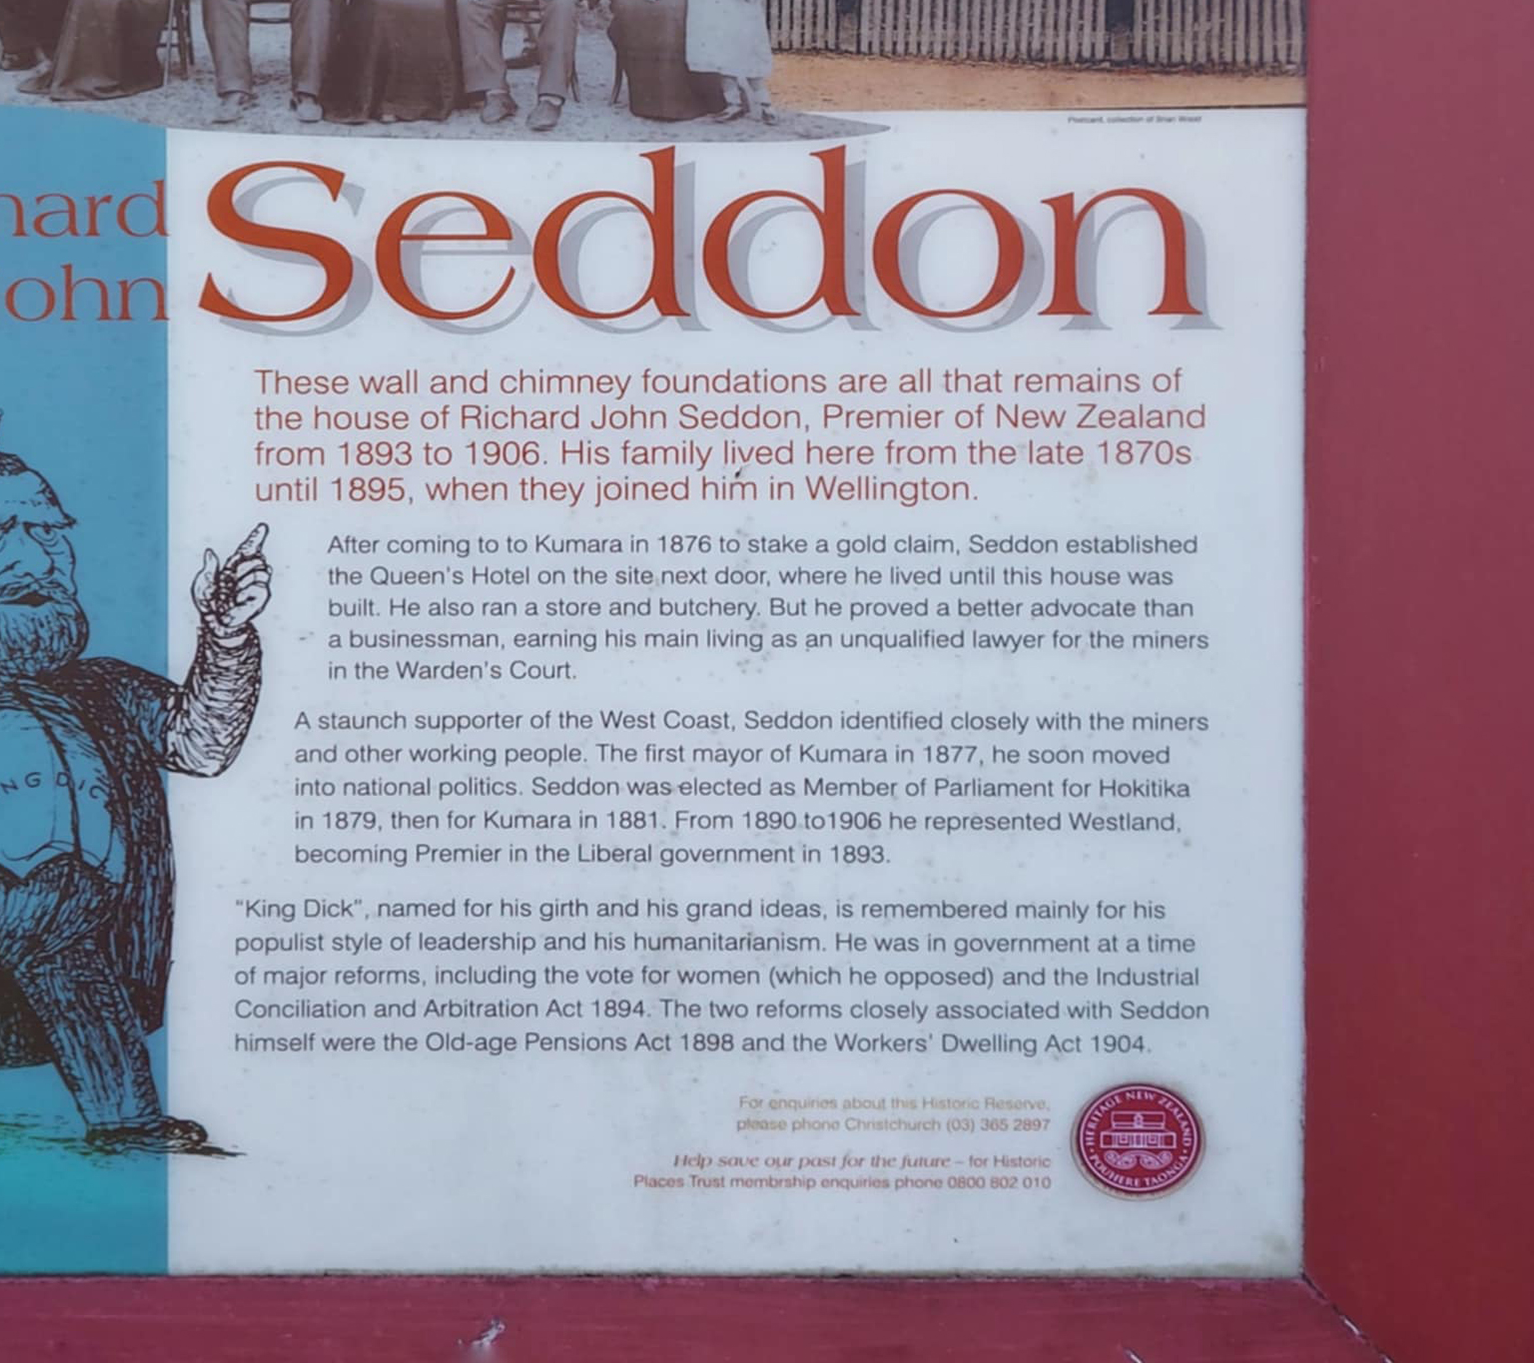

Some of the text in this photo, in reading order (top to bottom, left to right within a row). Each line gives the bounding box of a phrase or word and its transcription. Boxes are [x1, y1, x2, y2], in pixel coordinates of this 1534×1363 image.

[197, 145, 1204, 323] Seddon
[253, 366, 1183, 401] These wall and chimney foundations are all that remains of
[254, 399, 1206, 433] the house of Richard John Seddon, Premier of New Zealand
[254, 439, 1192, 475] from 1893 to 1906. His family lived here from the late 1870s
[255, 475, 978, 508] until 1895, when they joined him in Wellington.
[326, 533, 1198, 559] After coming to to Kumara in 1876 to stake a gold claim, Seddon established
[738, 1094, 1051, 1112] For enquiries about this Historic Reserve,
[1085, 1089, 1193, 1146] HERITAGE NEW ZEALAND
[735, 1116, 1052, 1134] please phone Christchurch (03) 365 2897
[672, 1150, 1051, 1171] Help save our past for the future for Historic
[633, 1173, 1052, 1192] Places Trust membrship enquiries phone 0800 802 010
